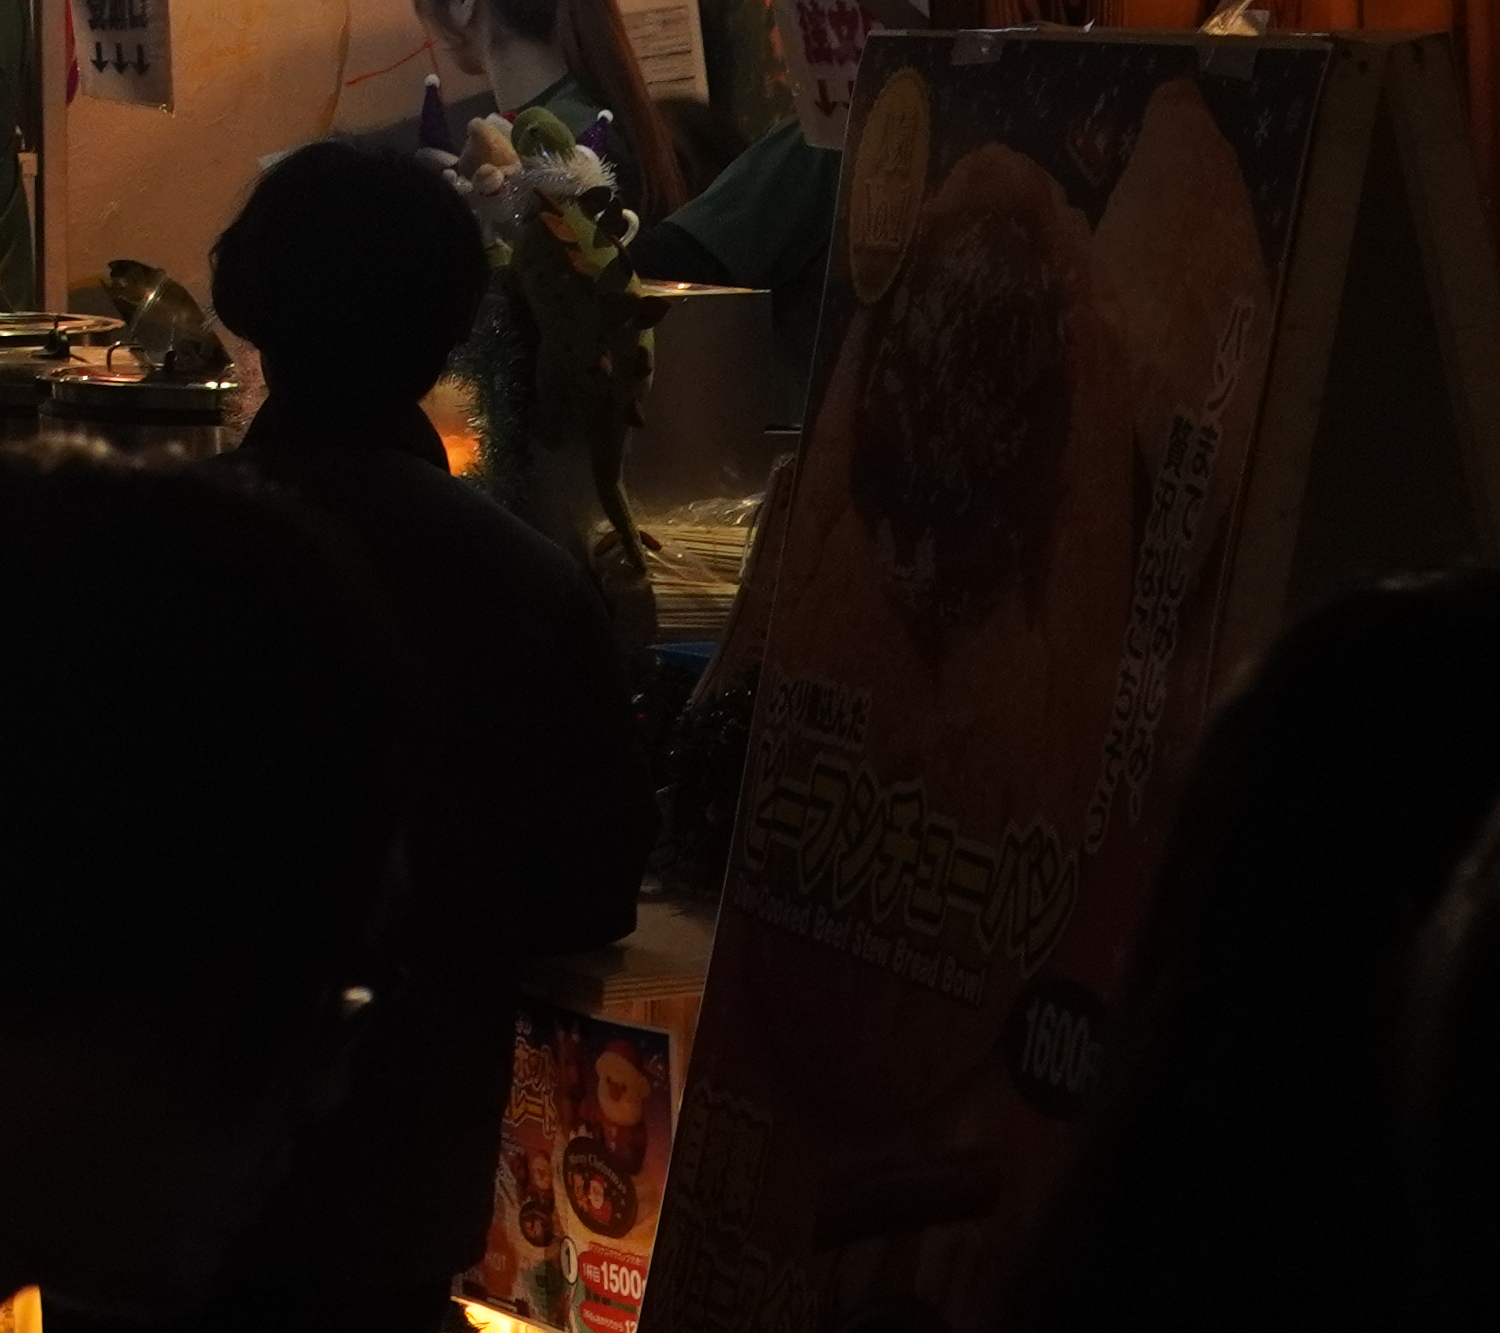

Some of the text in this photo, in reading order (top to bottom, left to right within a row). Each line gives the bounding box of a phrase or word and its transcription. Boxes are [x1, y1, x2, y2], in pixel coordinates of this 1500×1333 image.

[745, 735, 1079, 977] ビーフシチューパン
[812, 905, 851, 950] Beef
[851, 920, 893, 967] Stew
[893, 937, 941, 988] Bread
[941, 955, 987, 1006] Bowl
[503, 1086, 557, 1140] レート
[601, 1261, 645, 1300] 1500
